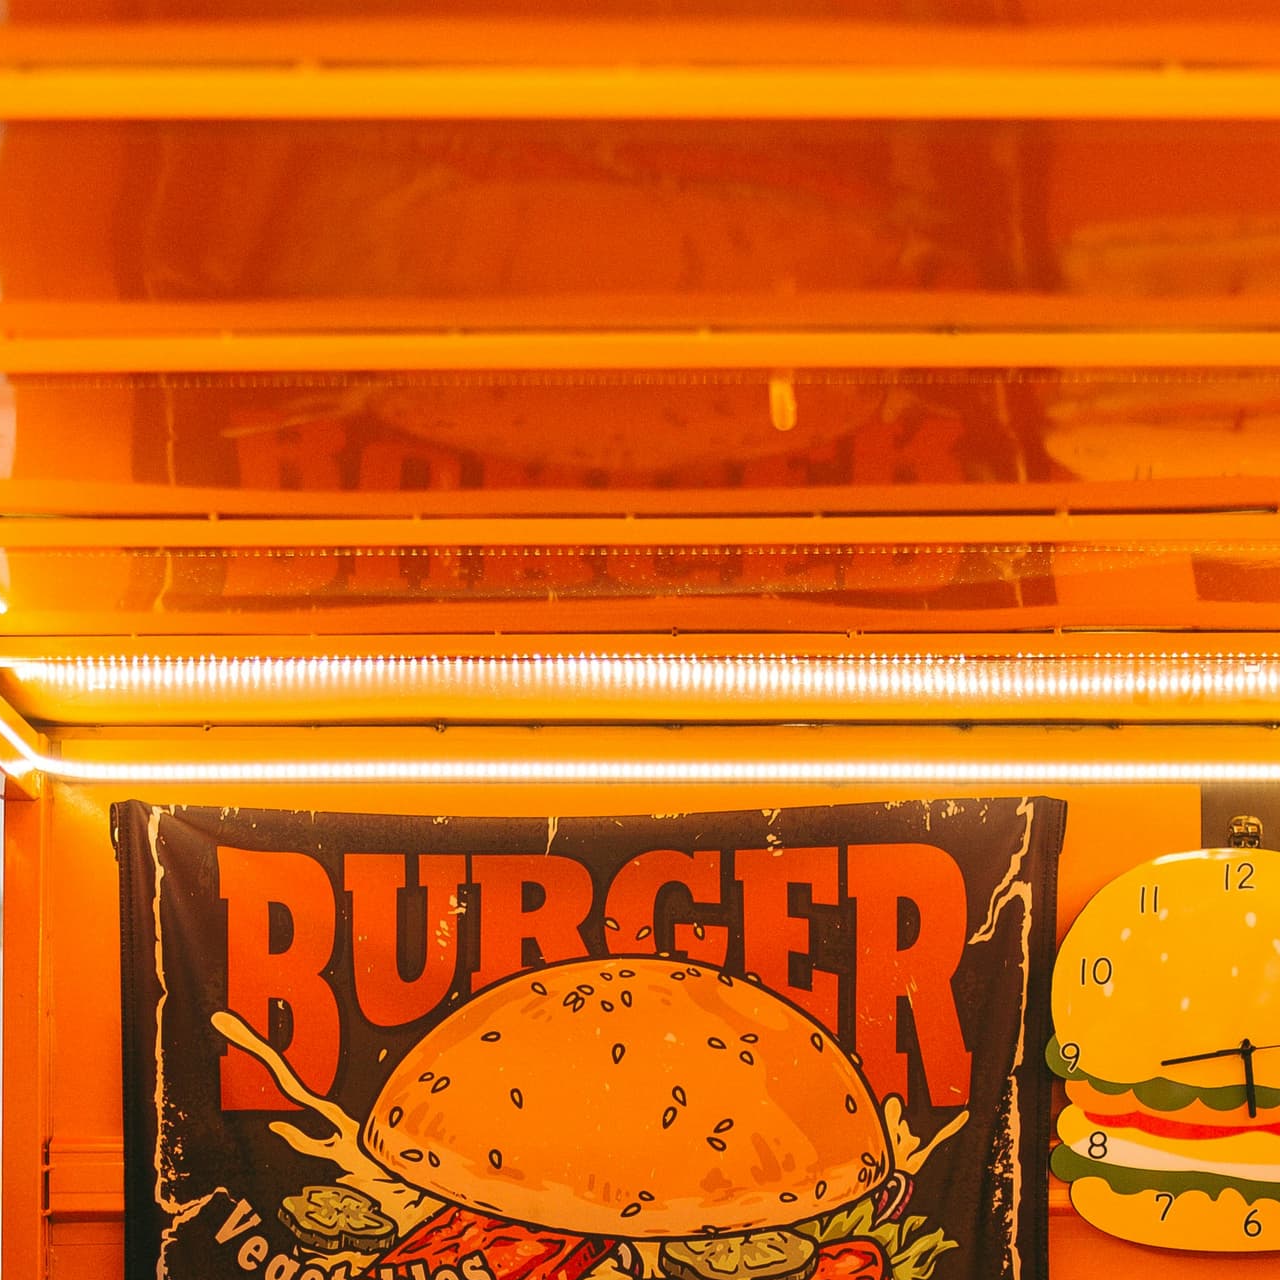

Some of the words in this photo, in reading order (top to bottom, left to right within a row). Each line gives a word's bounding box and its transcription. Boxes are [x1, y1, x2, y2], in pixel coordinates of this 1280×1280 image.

[1225, 863, 1254, 891] 12
[1140, 885, 1159, 913] 11
[217, 843, 971, 1111] BURGER
[1081, 957, 1112, 985] 10
[1061, 1043, 1080, 1072] 9
[1088, 1131, 1108, 1159] 8
[1155, 1194, 1174, 1221] 7
[1243, 1210, 1263, 1237] 6
